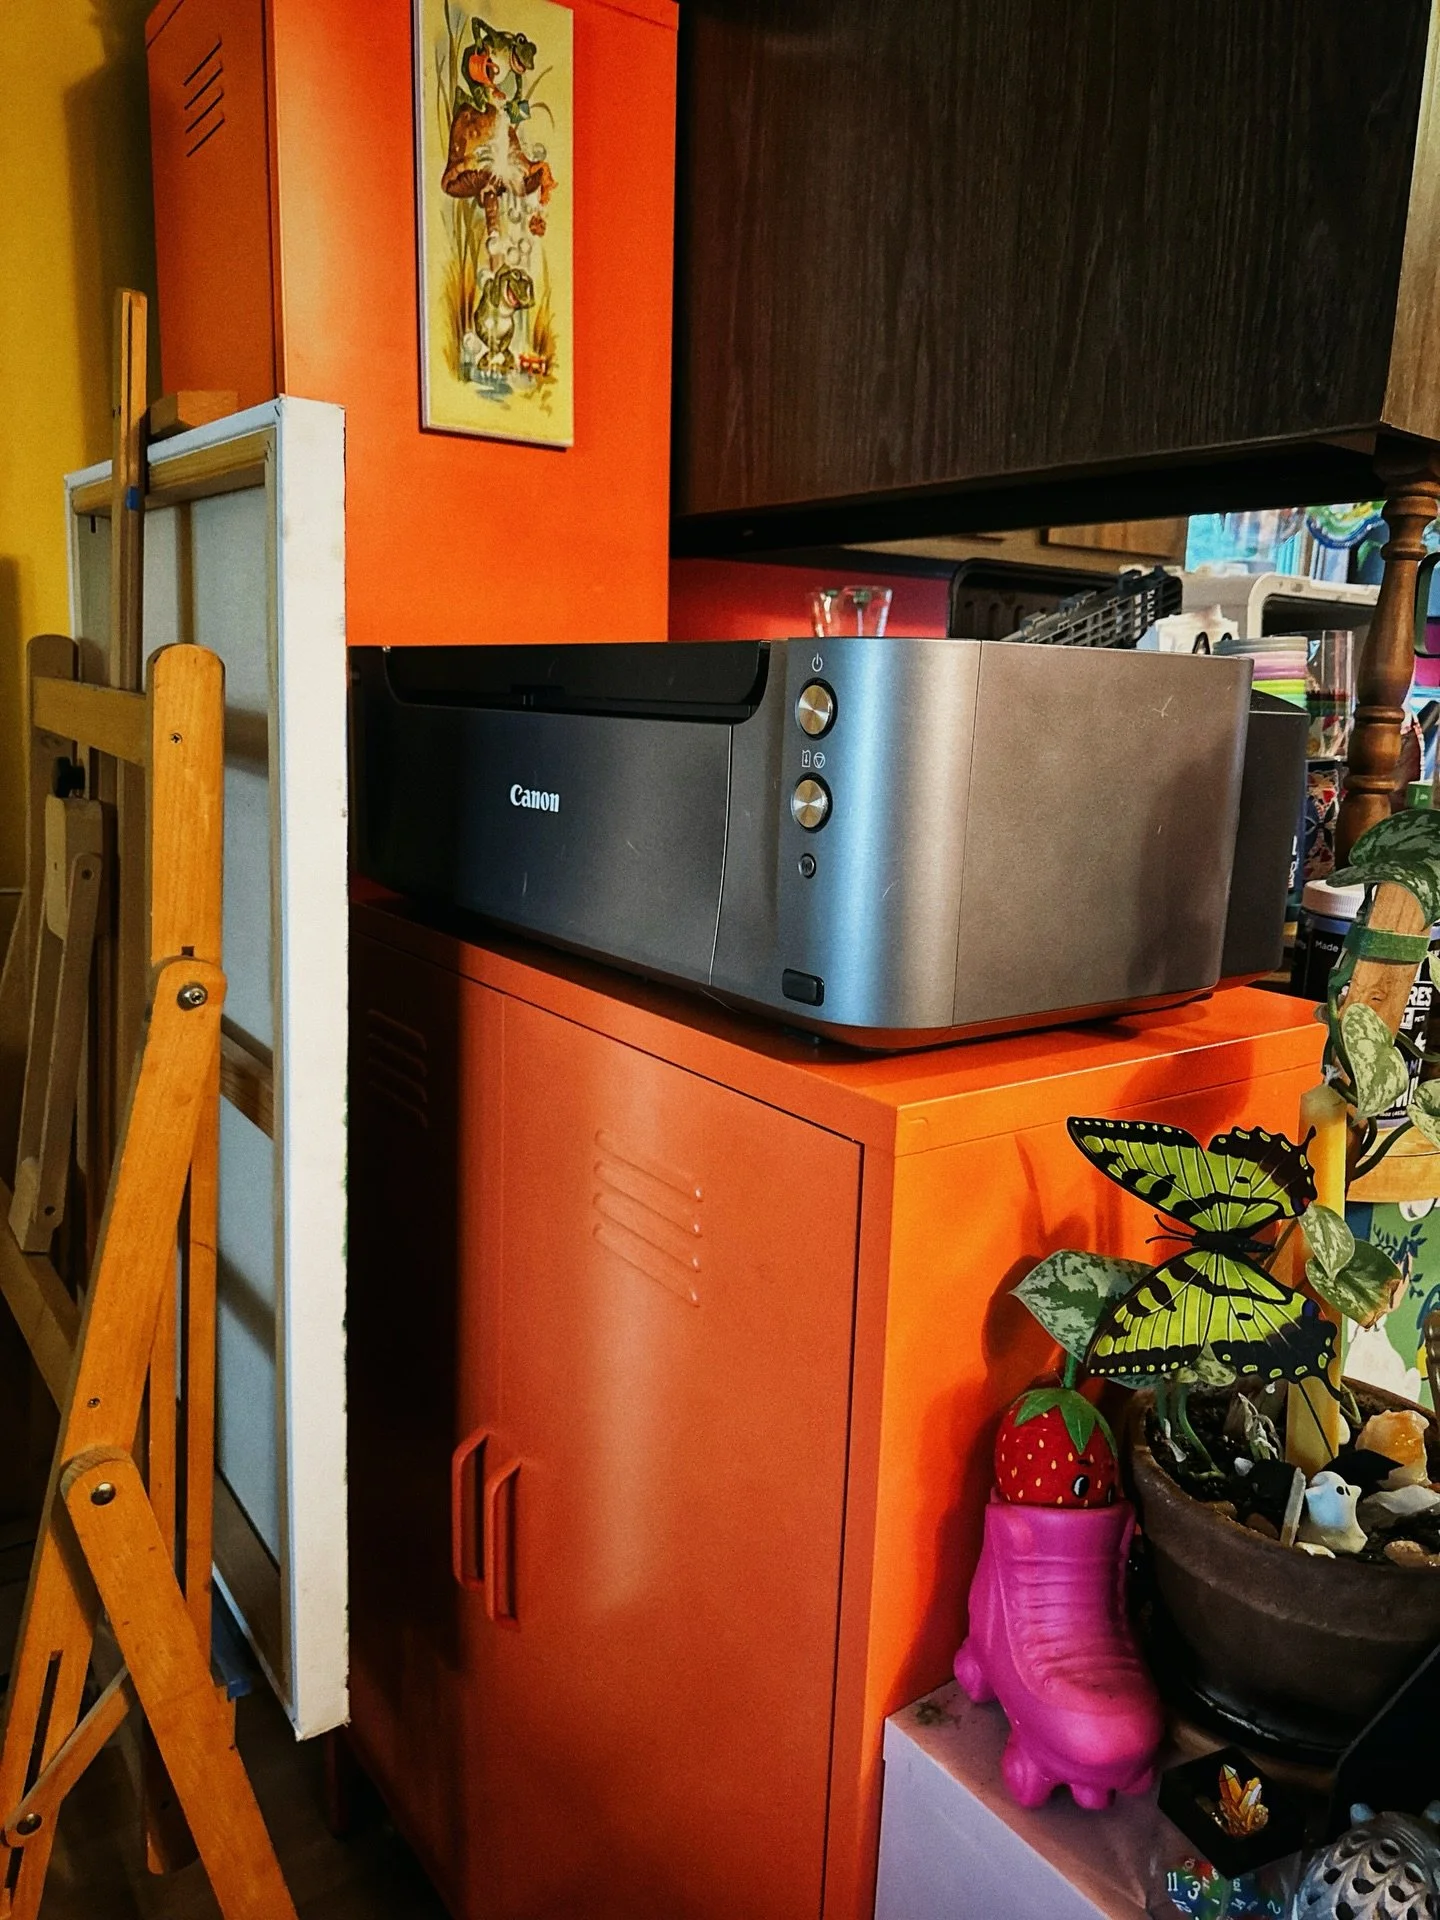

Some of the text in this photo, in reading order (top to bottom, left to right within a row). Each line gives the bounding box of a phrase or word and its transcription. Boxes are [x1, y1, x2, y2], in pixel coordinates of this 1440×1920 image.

[510, 784, 560, 812] Canon
[1315, 940, 1339, 952] Made
[1167, 1871, 1179, 1892] 11
[1187, 1880, 1201, 1900] 3
